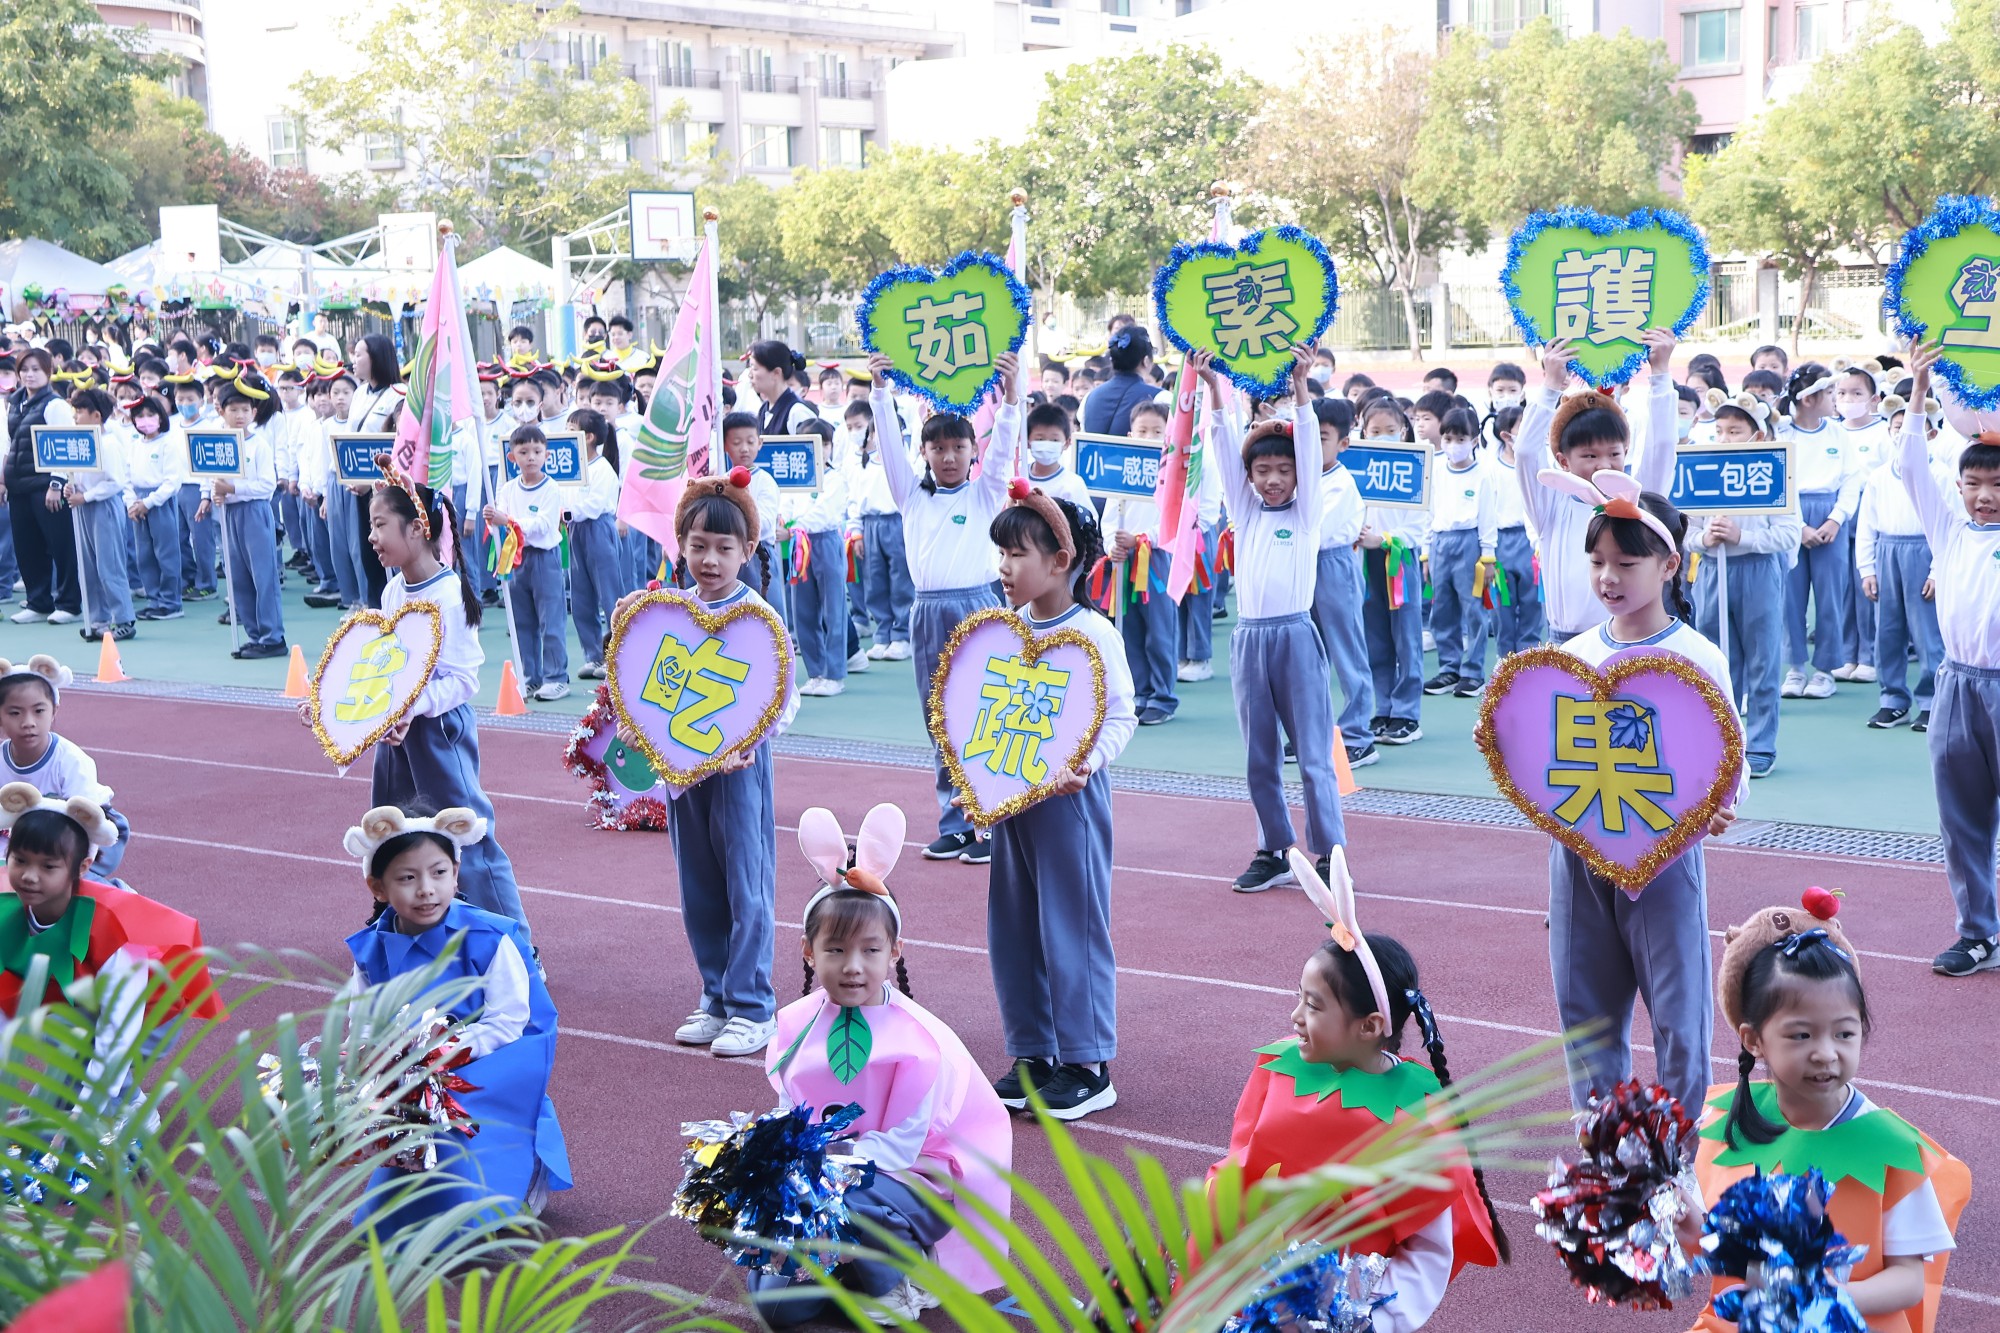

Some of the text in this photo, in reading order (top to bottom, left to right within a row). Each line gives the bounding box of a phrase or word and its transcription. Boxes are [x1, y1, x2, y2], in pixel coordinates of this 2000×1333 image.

[906, 293, 989, 381] 茹
[1205, 261, 1298, 358] 素
[1555, 248, 1655, 345] 護
[43, 437, 91, 461] 小三善解
[195, 442, 236, 467] 小三感恩
[753, 450, 808, 480] 一善解
[1085, 451, 1159, 488] 小一感恩
[1350, 458, 1413, 494] 一知足
[1672, 460, 1774, 499] 小二包容
[335, 632, 406, 724] 多
[640, 633, 751, 755] 吃
[963, 655, 1071, 787] 蔬
[1548, 695, 1678, 833] 果
